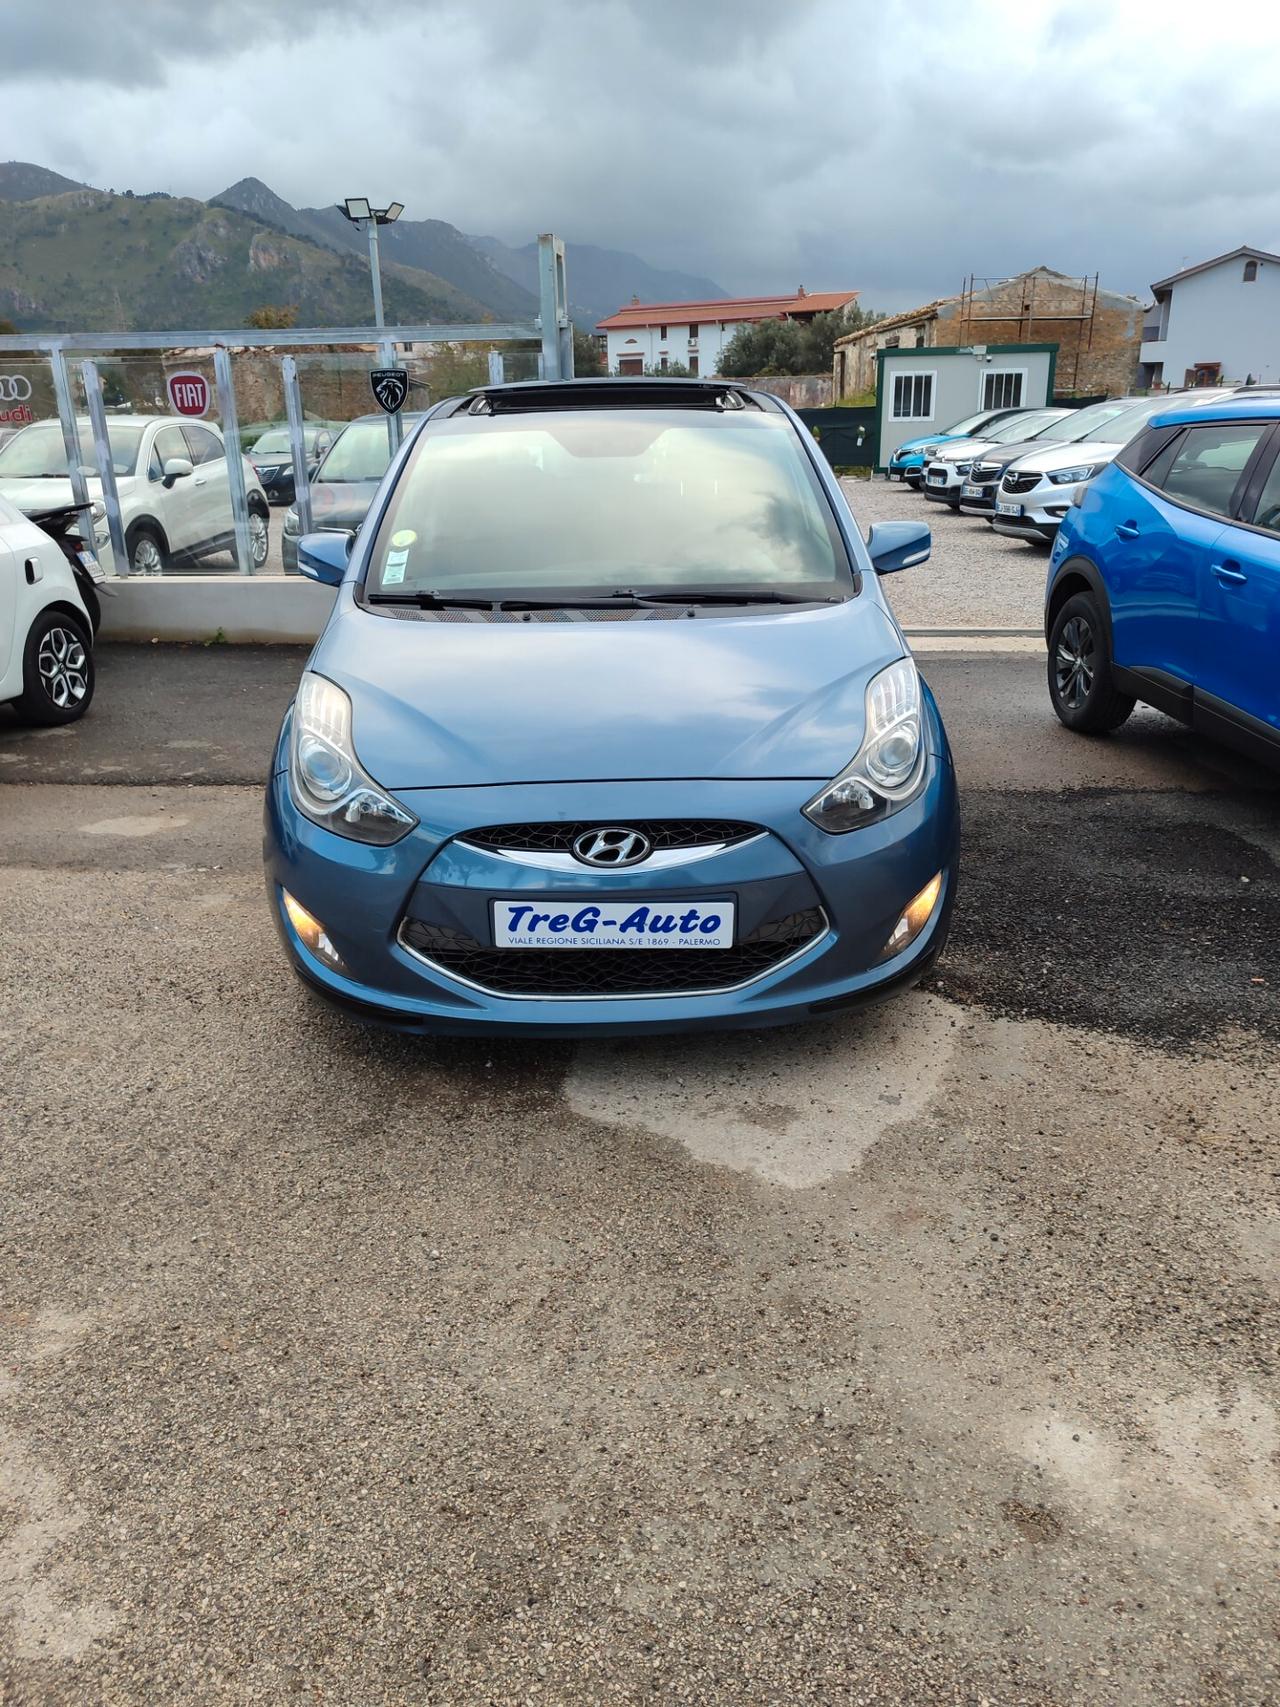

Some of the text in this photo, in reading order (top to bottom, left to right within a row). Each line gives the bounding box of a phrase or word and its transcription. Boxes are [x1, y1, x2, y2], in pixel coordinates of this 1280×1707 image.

[174, 383, 203, 407] FIAT
[0, 403, 32, 422] udi
[508, 906, 721, 934] TreG-Auto
[508, 937, 533, 945] VIALE
[536, 937, 578, 945] REGIONE
[581, 937, 626, 946] SICILIANA
[629, 937, 643, 946] S/E
[647, 938, 669, 946] 1869
[679, 938, 721, 946] PALERMO
